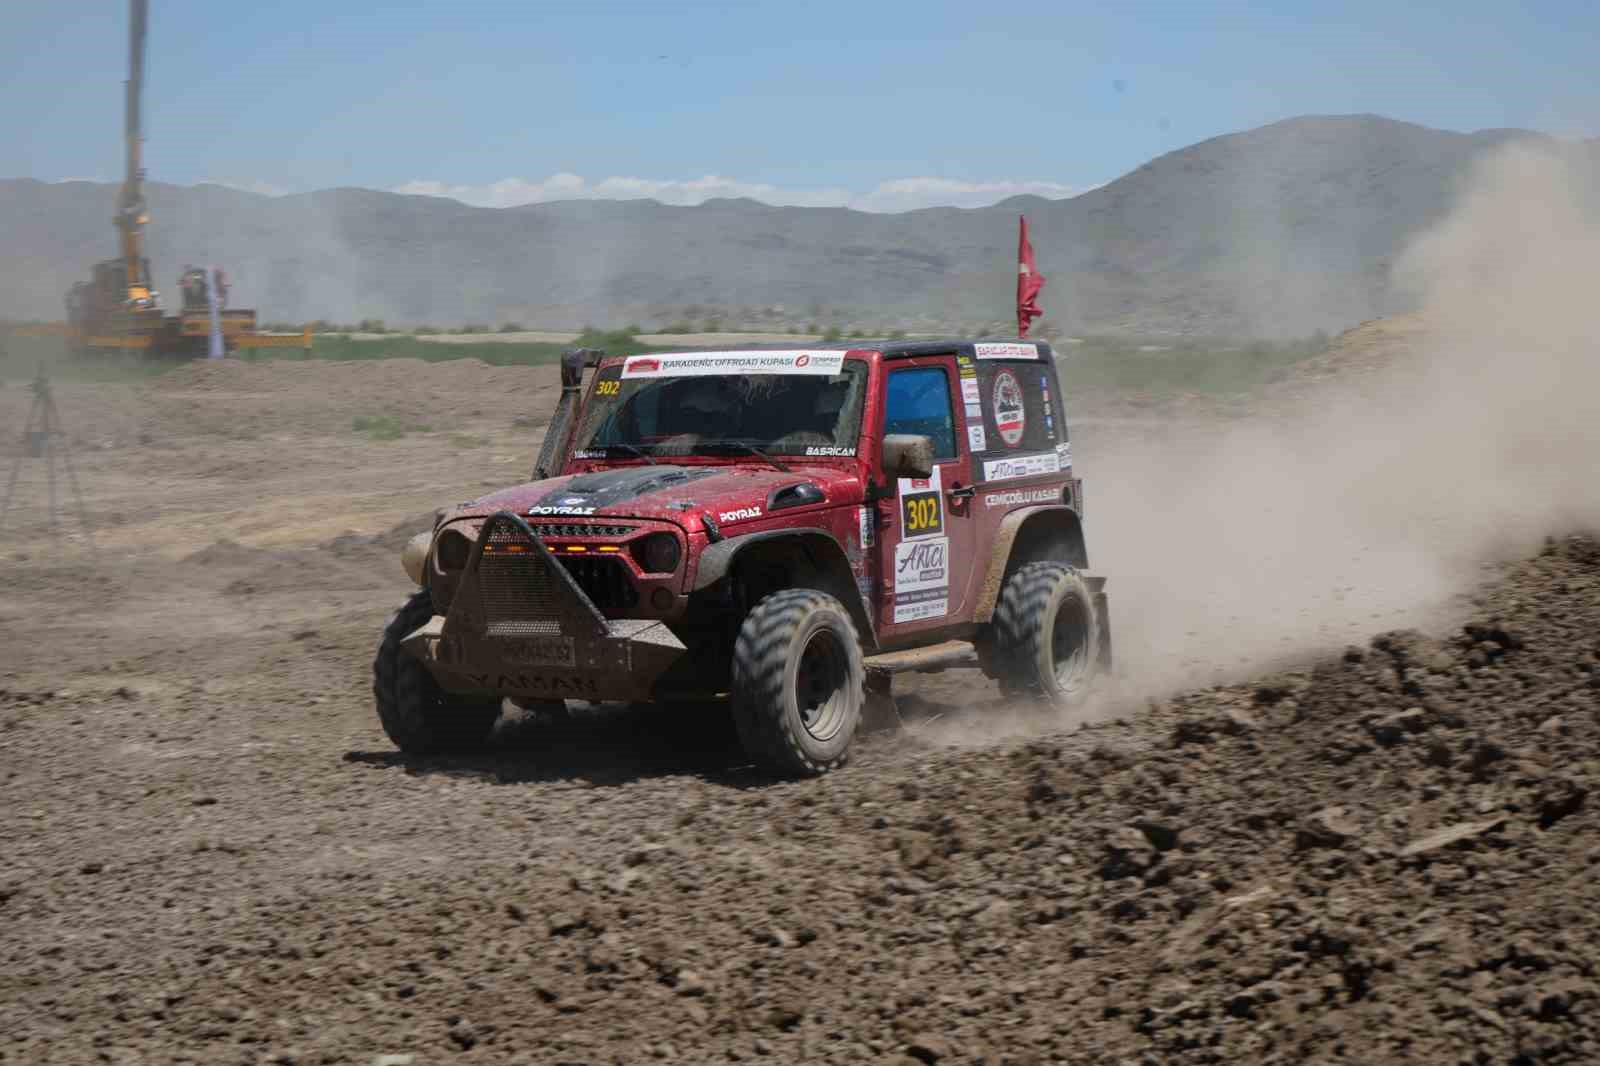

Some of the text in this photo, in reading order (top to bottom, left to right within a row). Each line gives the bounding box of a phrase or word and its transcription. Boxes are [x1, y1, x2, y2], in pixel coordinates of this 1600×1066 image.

[714, 357, 758, 368] OFFROAD
[759, 357, 794, 367] KUPASI
[596, 380, 620, 396] 302
[528, 505, 596, 515] POYRAZ
[719, 506, 763, 522] POYRAZ
[907, 497, 938, 530] 302
